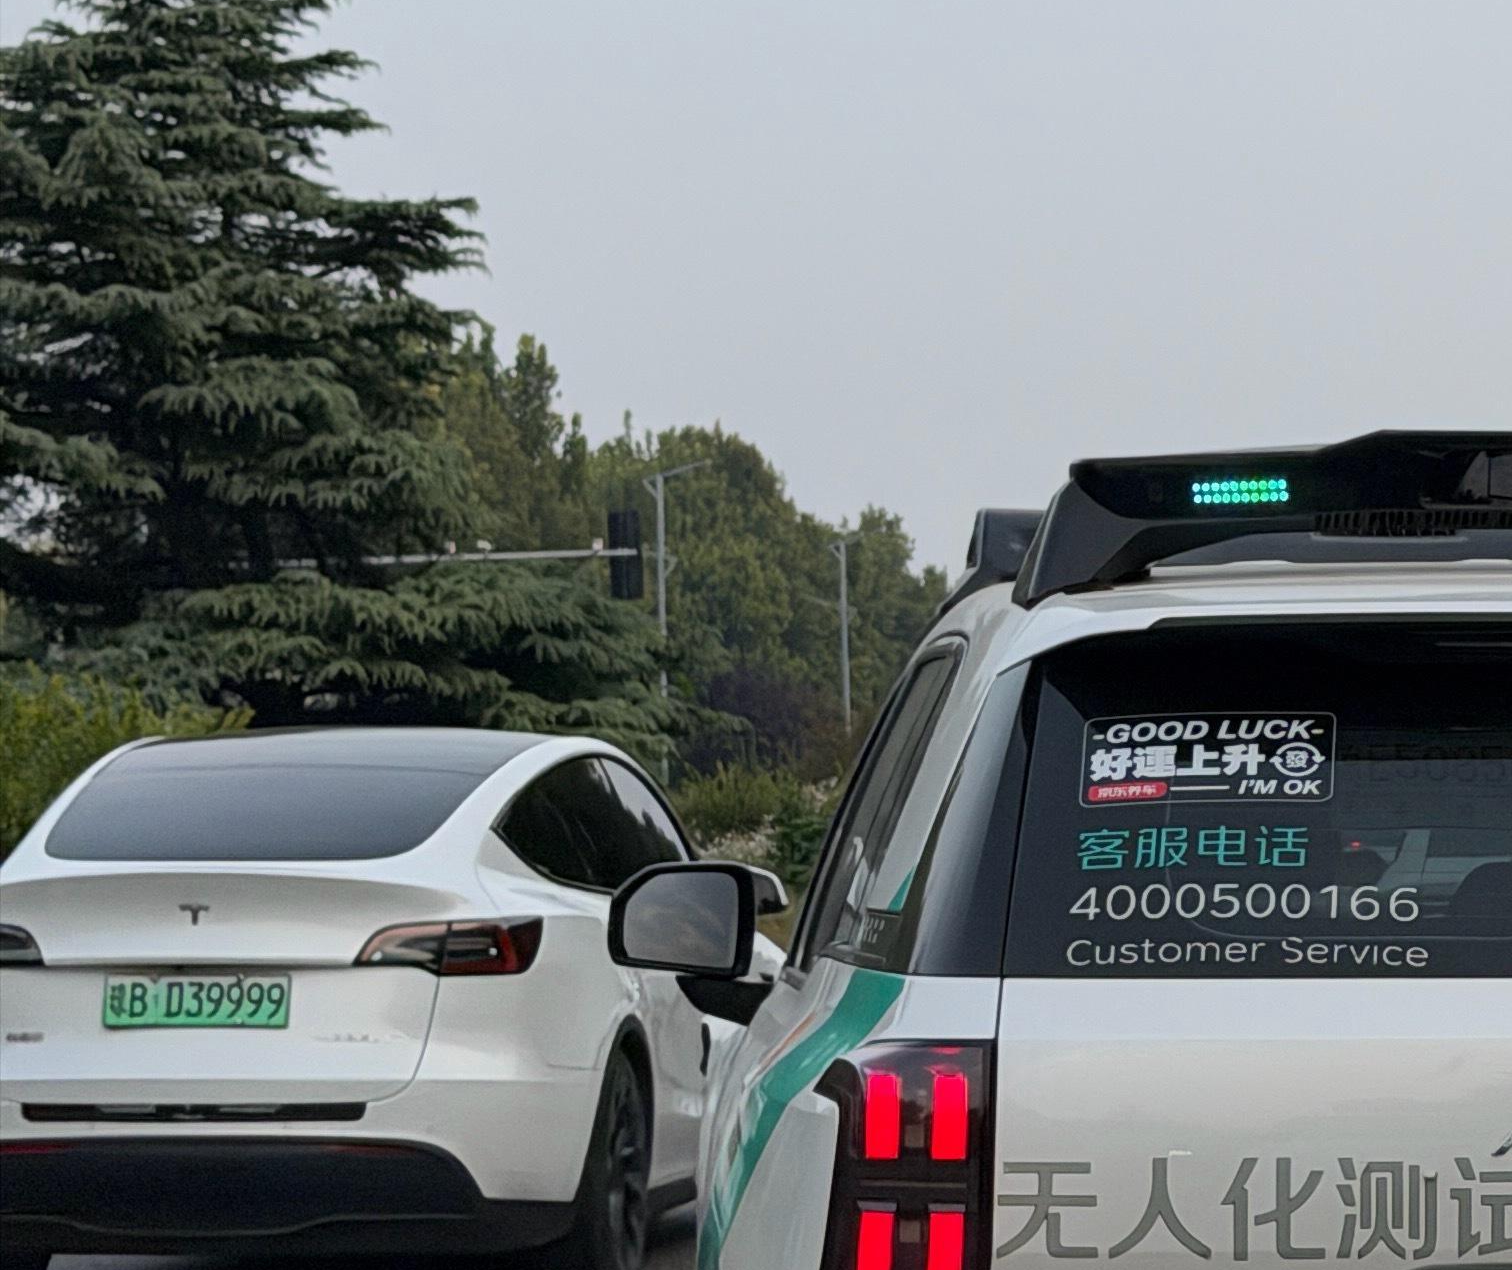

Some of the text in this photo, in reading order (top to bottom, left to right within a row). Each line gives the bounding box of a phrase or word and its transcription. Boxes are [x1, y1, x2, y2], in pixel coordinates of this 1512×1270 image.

[1089, 743, 1267, 782] 好運上升
[1238, 779, 1323, 796] I'M OK
[1077, 825, 1310, 871] 客服电话
[1068, 882, 1420, 922] 4000500166
[1066, 936, 1430, 967] Customer Service
